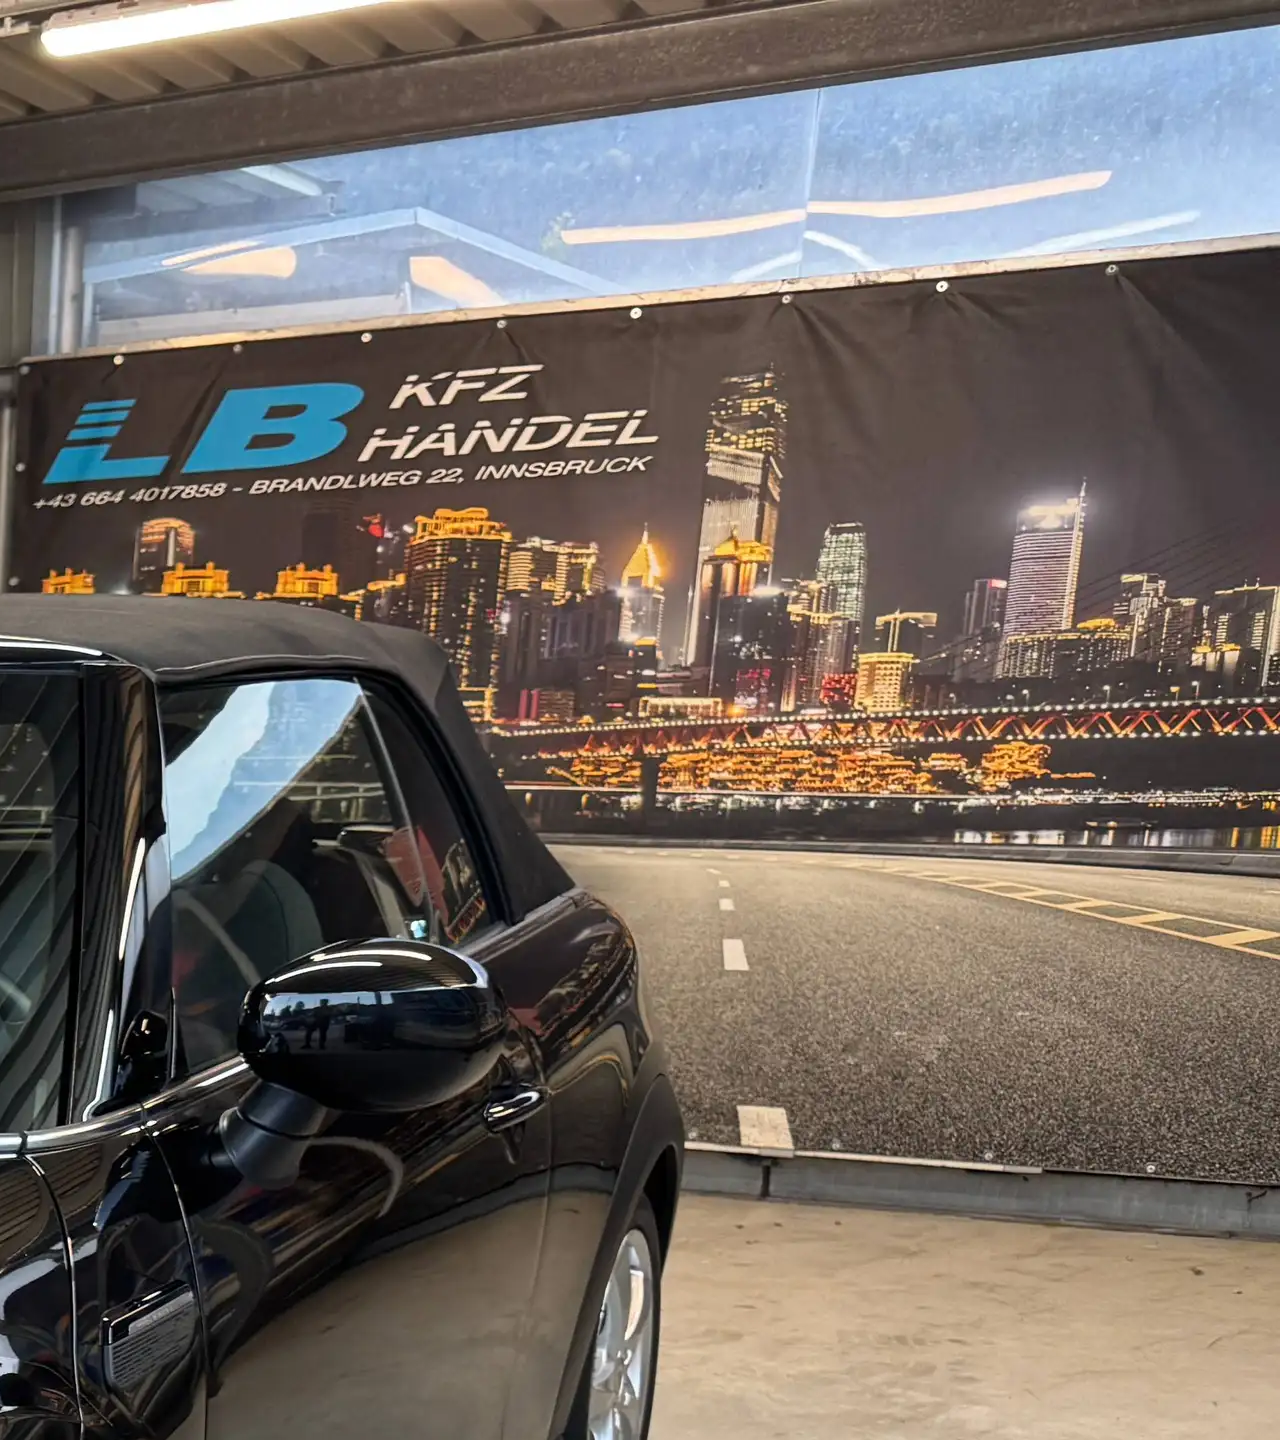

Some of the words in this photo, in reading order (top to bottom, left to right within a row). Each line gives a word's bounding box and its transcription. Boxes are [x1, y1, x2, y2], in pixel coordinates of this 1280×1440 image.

[389, 364, 544, 410] KFZ
[43, 382, 365, 484] LB
[357, 409, 659, 462] HANDEL
[33, 491, 76, 509] +43
[80, 488, 122, 507] 664
[129, 482, 228, 503] 4017858
[249, 469, 421, 495] BRANDLWEG
[425, 468, 464, 485] 22,
[474, 456, 654, 481] INNSBRUCK
